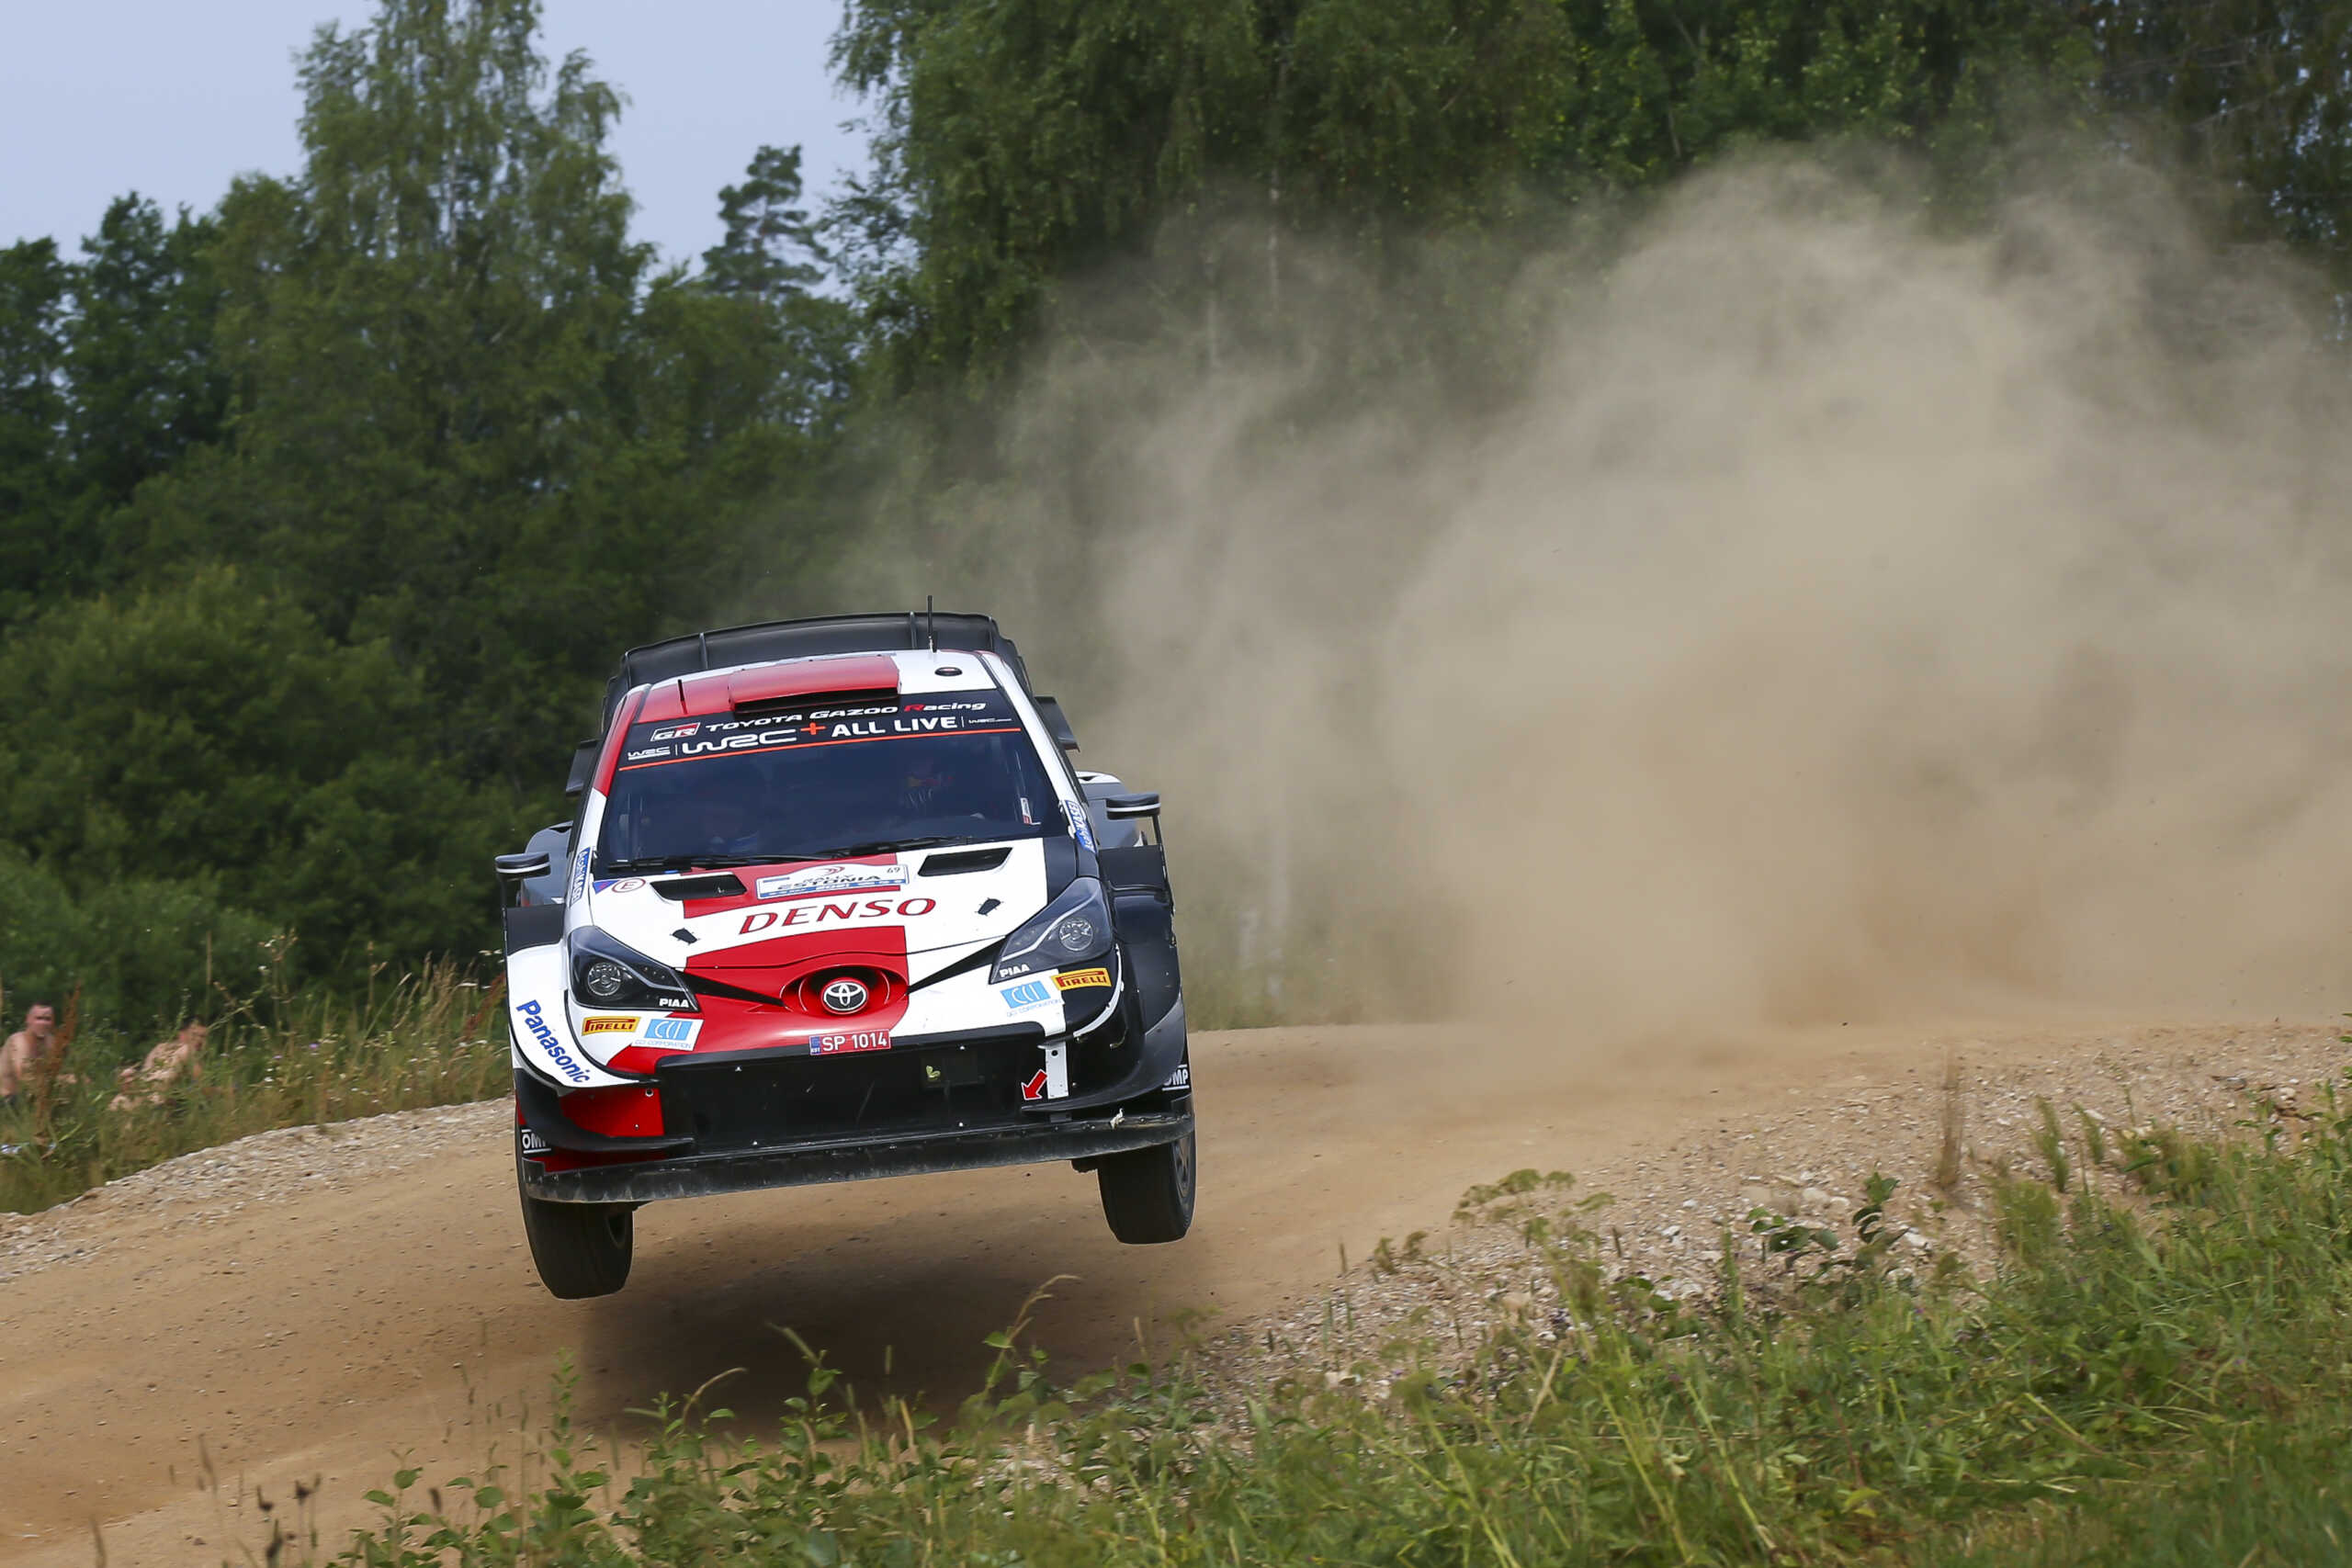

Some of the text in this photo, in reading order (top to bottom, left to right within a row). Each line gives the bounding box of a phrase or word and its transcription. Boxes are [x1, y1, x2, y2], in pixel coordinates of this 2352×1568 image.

[651, 702, 988, 740] GR TOYOTA GAZOO Racing
[682, 728, 797, 755] WRC
[831, 721, 887, 738] ALL
[894, 716, 958, 733] LIVE
[777, 875, 881, 890] ESTONIA
[739, 897, 936, 935] DENSO
[999, 964, 1030, 978] PIAA
[1057, 971, 1107, 987] PIRELLI
[659, 998, 689, 1008] PIAA
[584, 1019, 637, 1032] PIRELLI
[515, 998, 591, 1084] Panasonic
[822, 1032, 888, 1052] SP 1014
